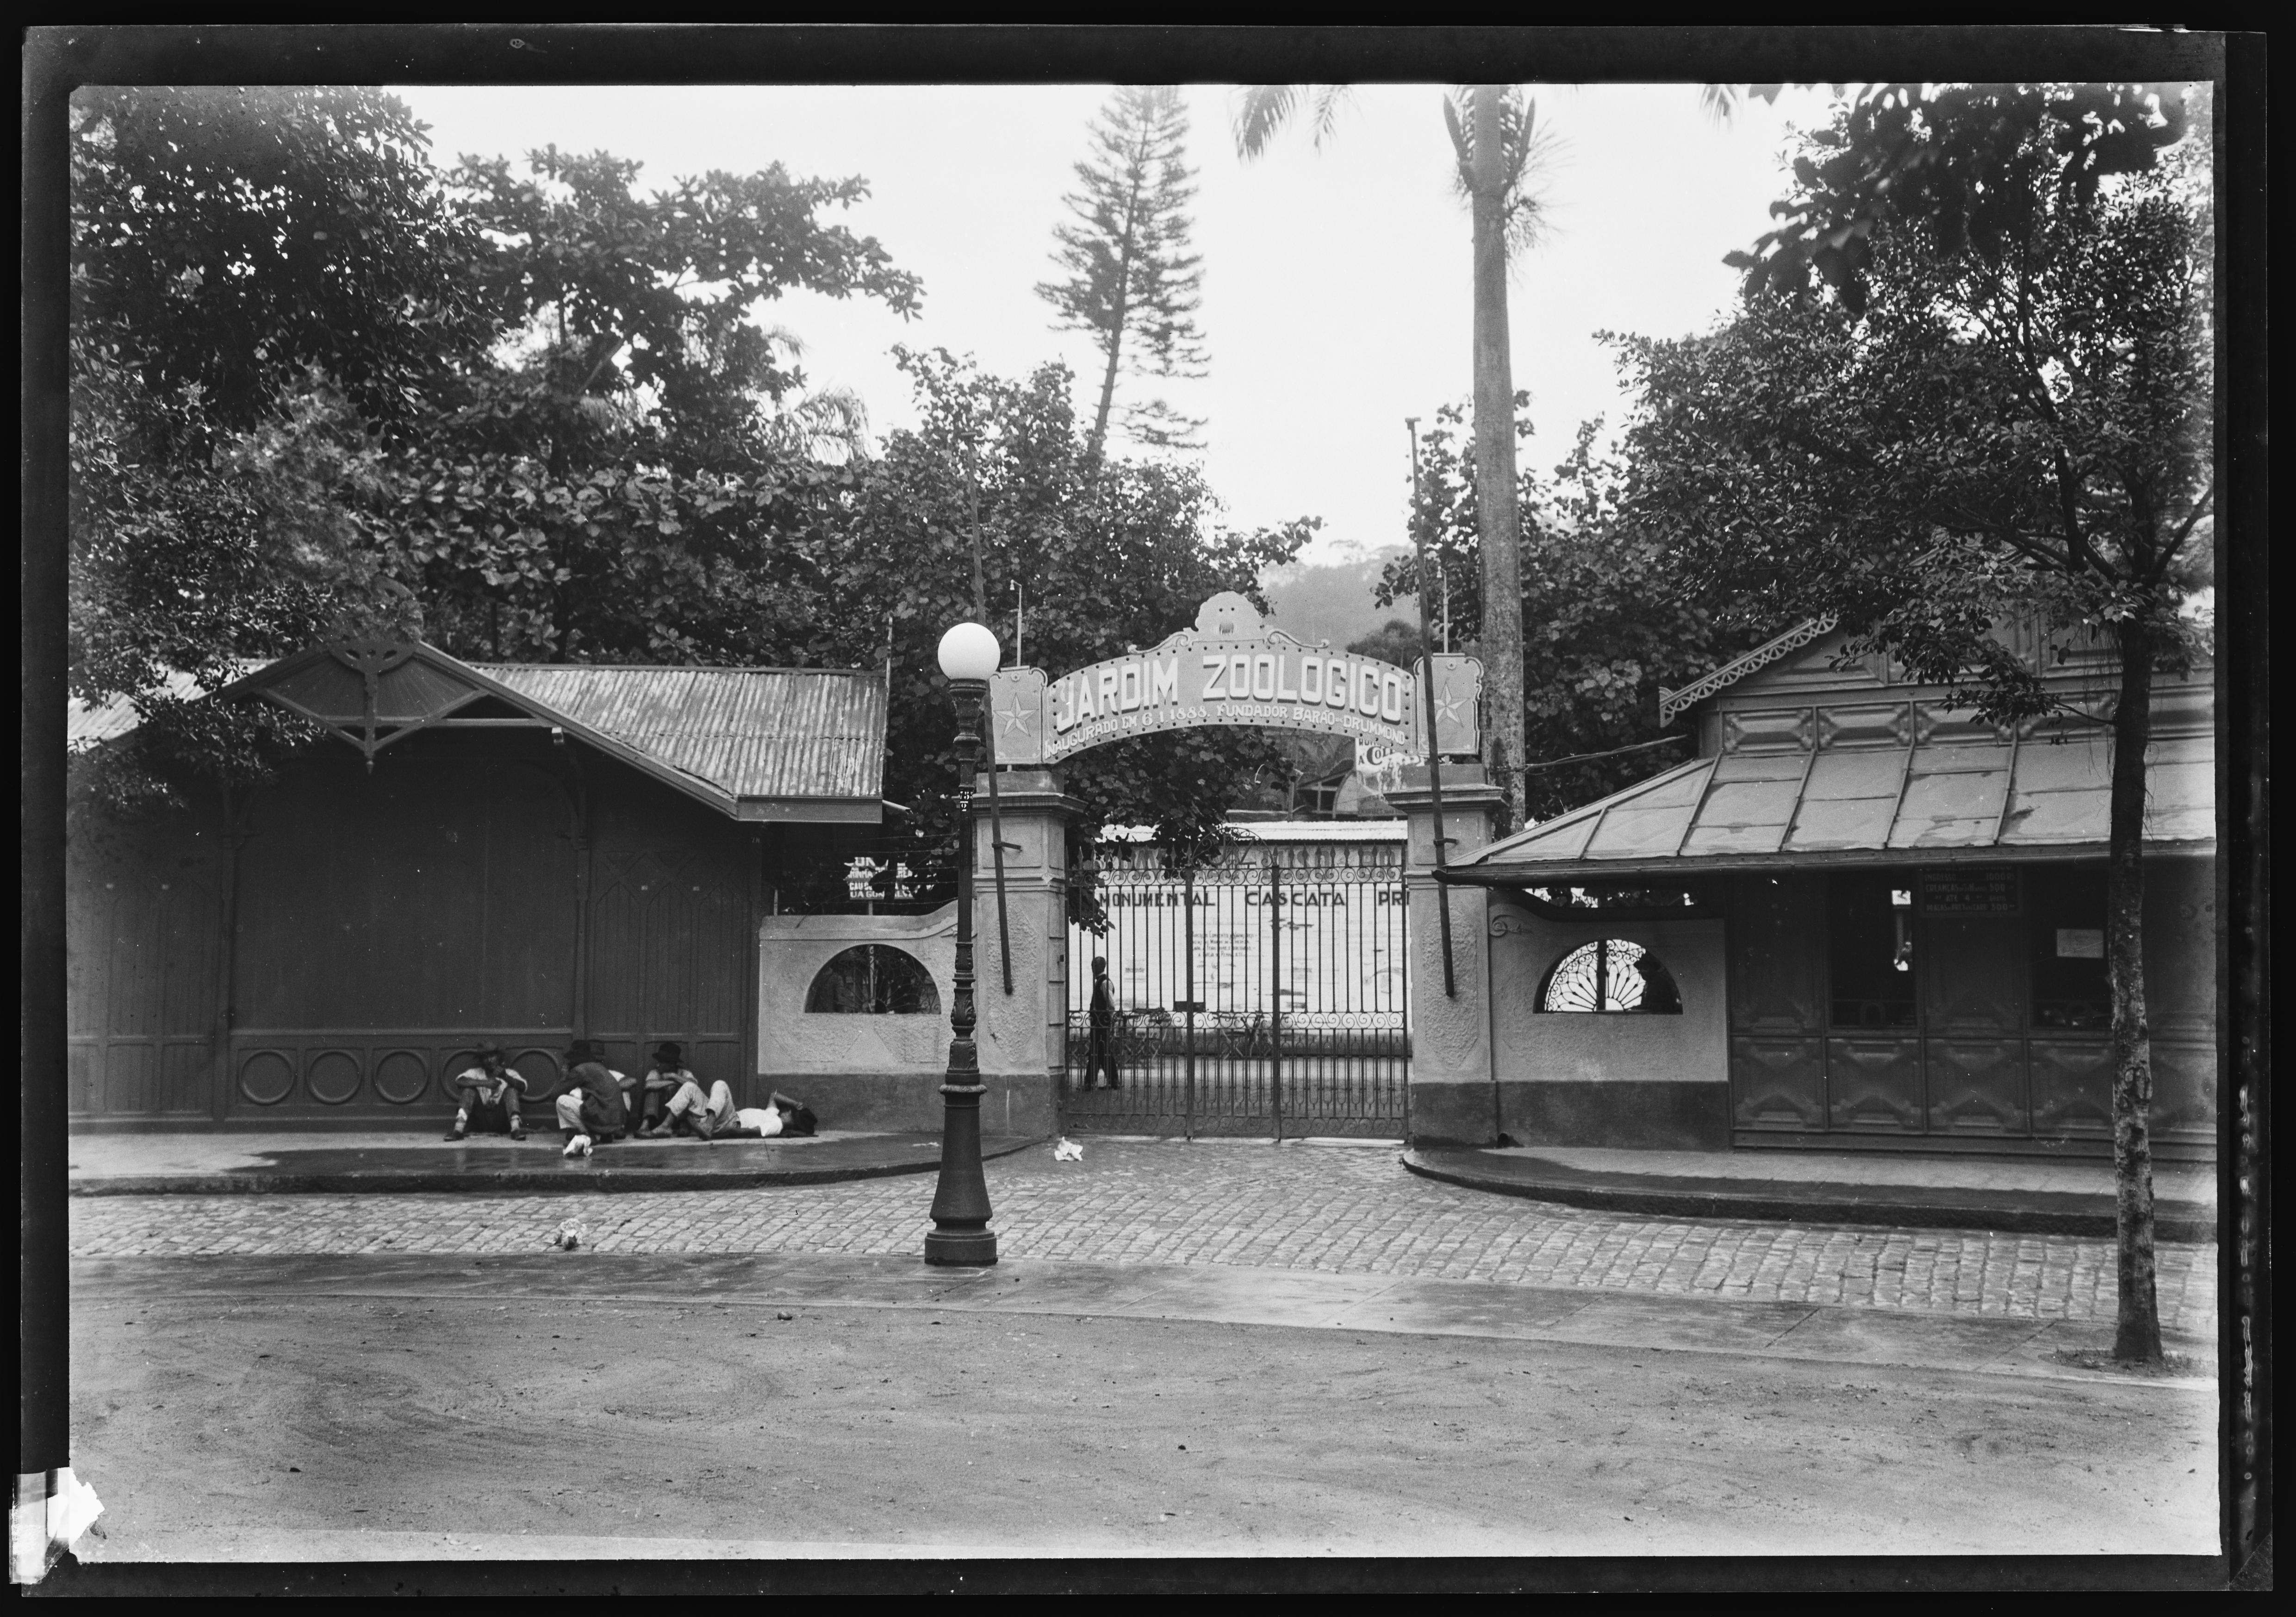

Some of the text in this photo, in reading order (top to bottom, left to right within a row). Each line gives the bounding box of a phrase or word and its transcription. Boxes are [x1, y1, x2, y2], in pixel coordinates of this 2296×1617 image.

[1057, 654, 1401, 734] JARDIM ZOOLOGICO
[1044, 719, 1118, 759] INAUGURADO
[1121, 716, 1137, 730] EM
[1217, 702, 1288, 718] FUNDADOR
[1293, 707, 1335, 725] BARÃO
[1344, 715, 1406, 745] DRUMMOND
[1099, 892, 1216, 907] MONUMENTAL
[1245, 892, 1345, 906] CASCATA
